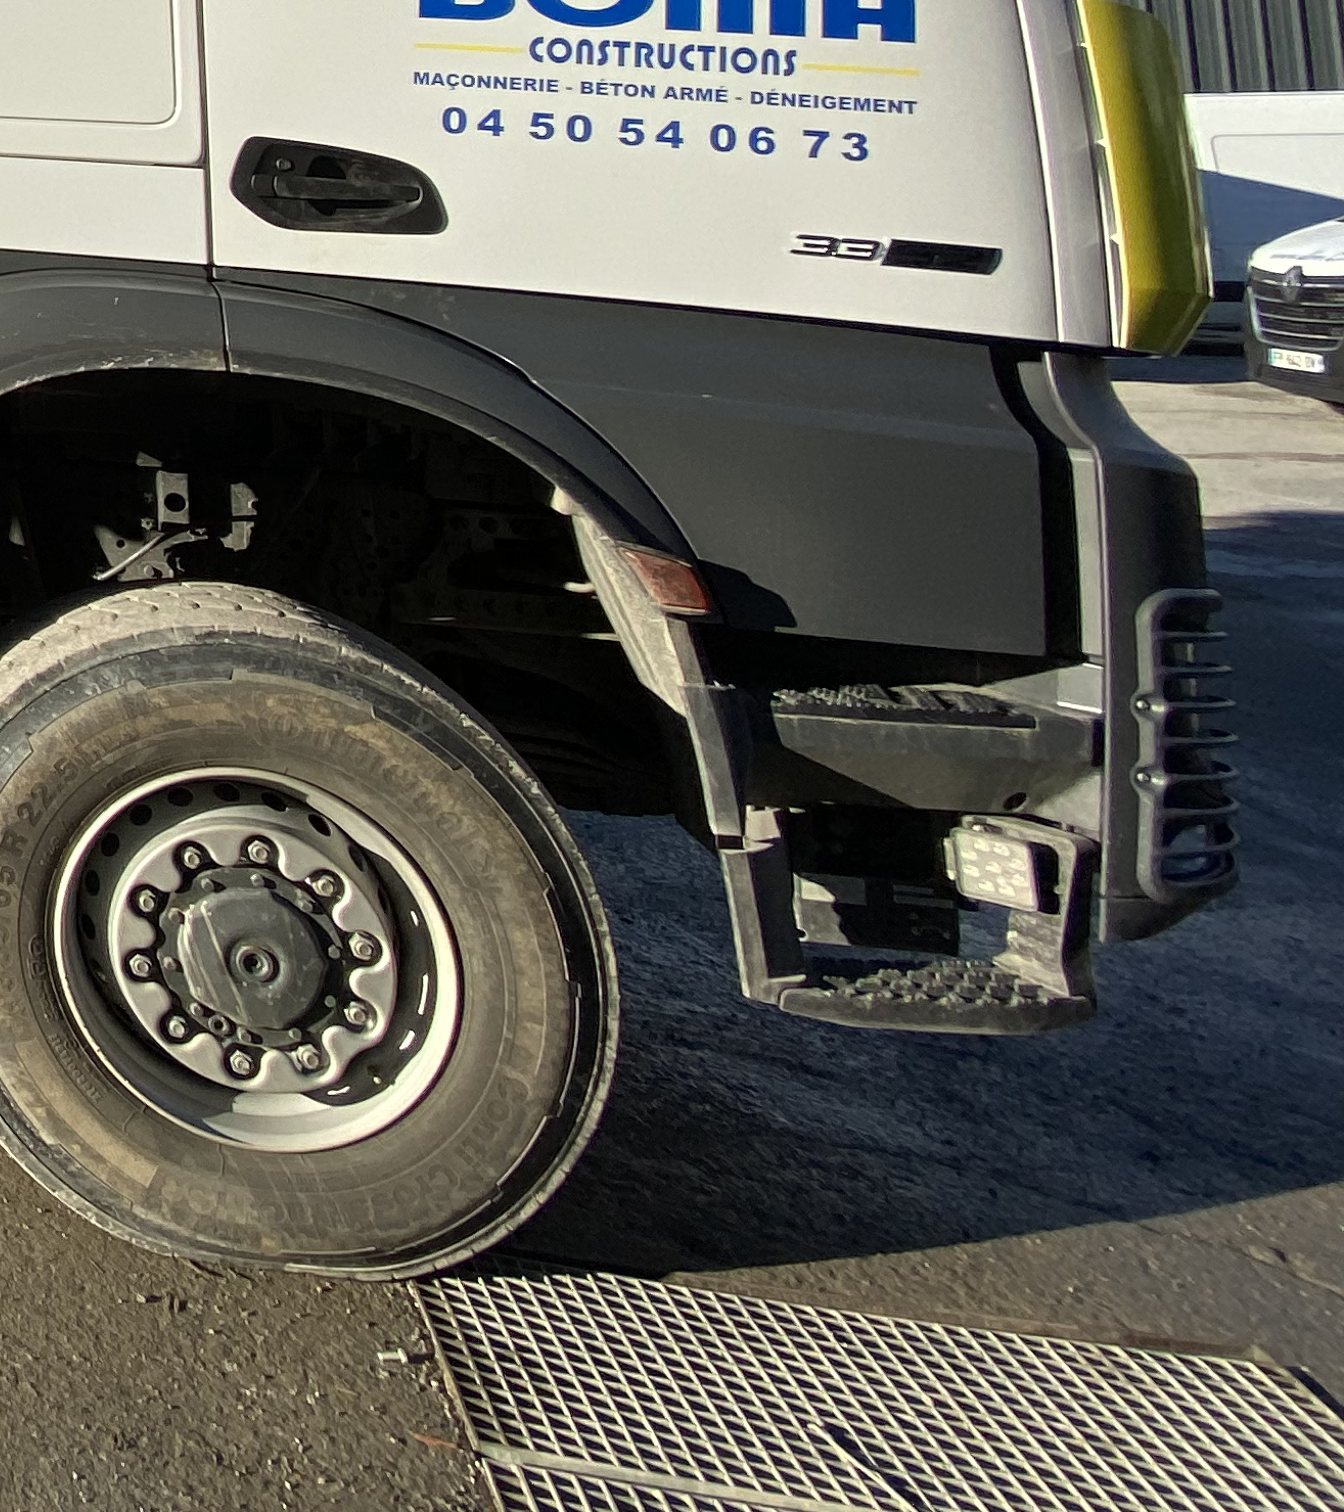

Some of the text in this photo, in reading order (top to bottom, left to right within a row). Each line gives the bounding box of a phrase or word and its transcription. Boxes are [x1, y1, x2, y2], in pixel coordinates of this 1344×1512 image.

[528, 36, 798, 77] CONSTRUCTIONS
[413, 71, 560, 93] MAÇONNERIE
[580, 77, 656, 100] BÉTON
[663, 83, 729, 103] ARMÉ
[750, 88, 918, 115] DÉNEIGEMENT
[442, 106, 869, 162] 04 50 54 06 73
[789, 233, 881, 262] 33
